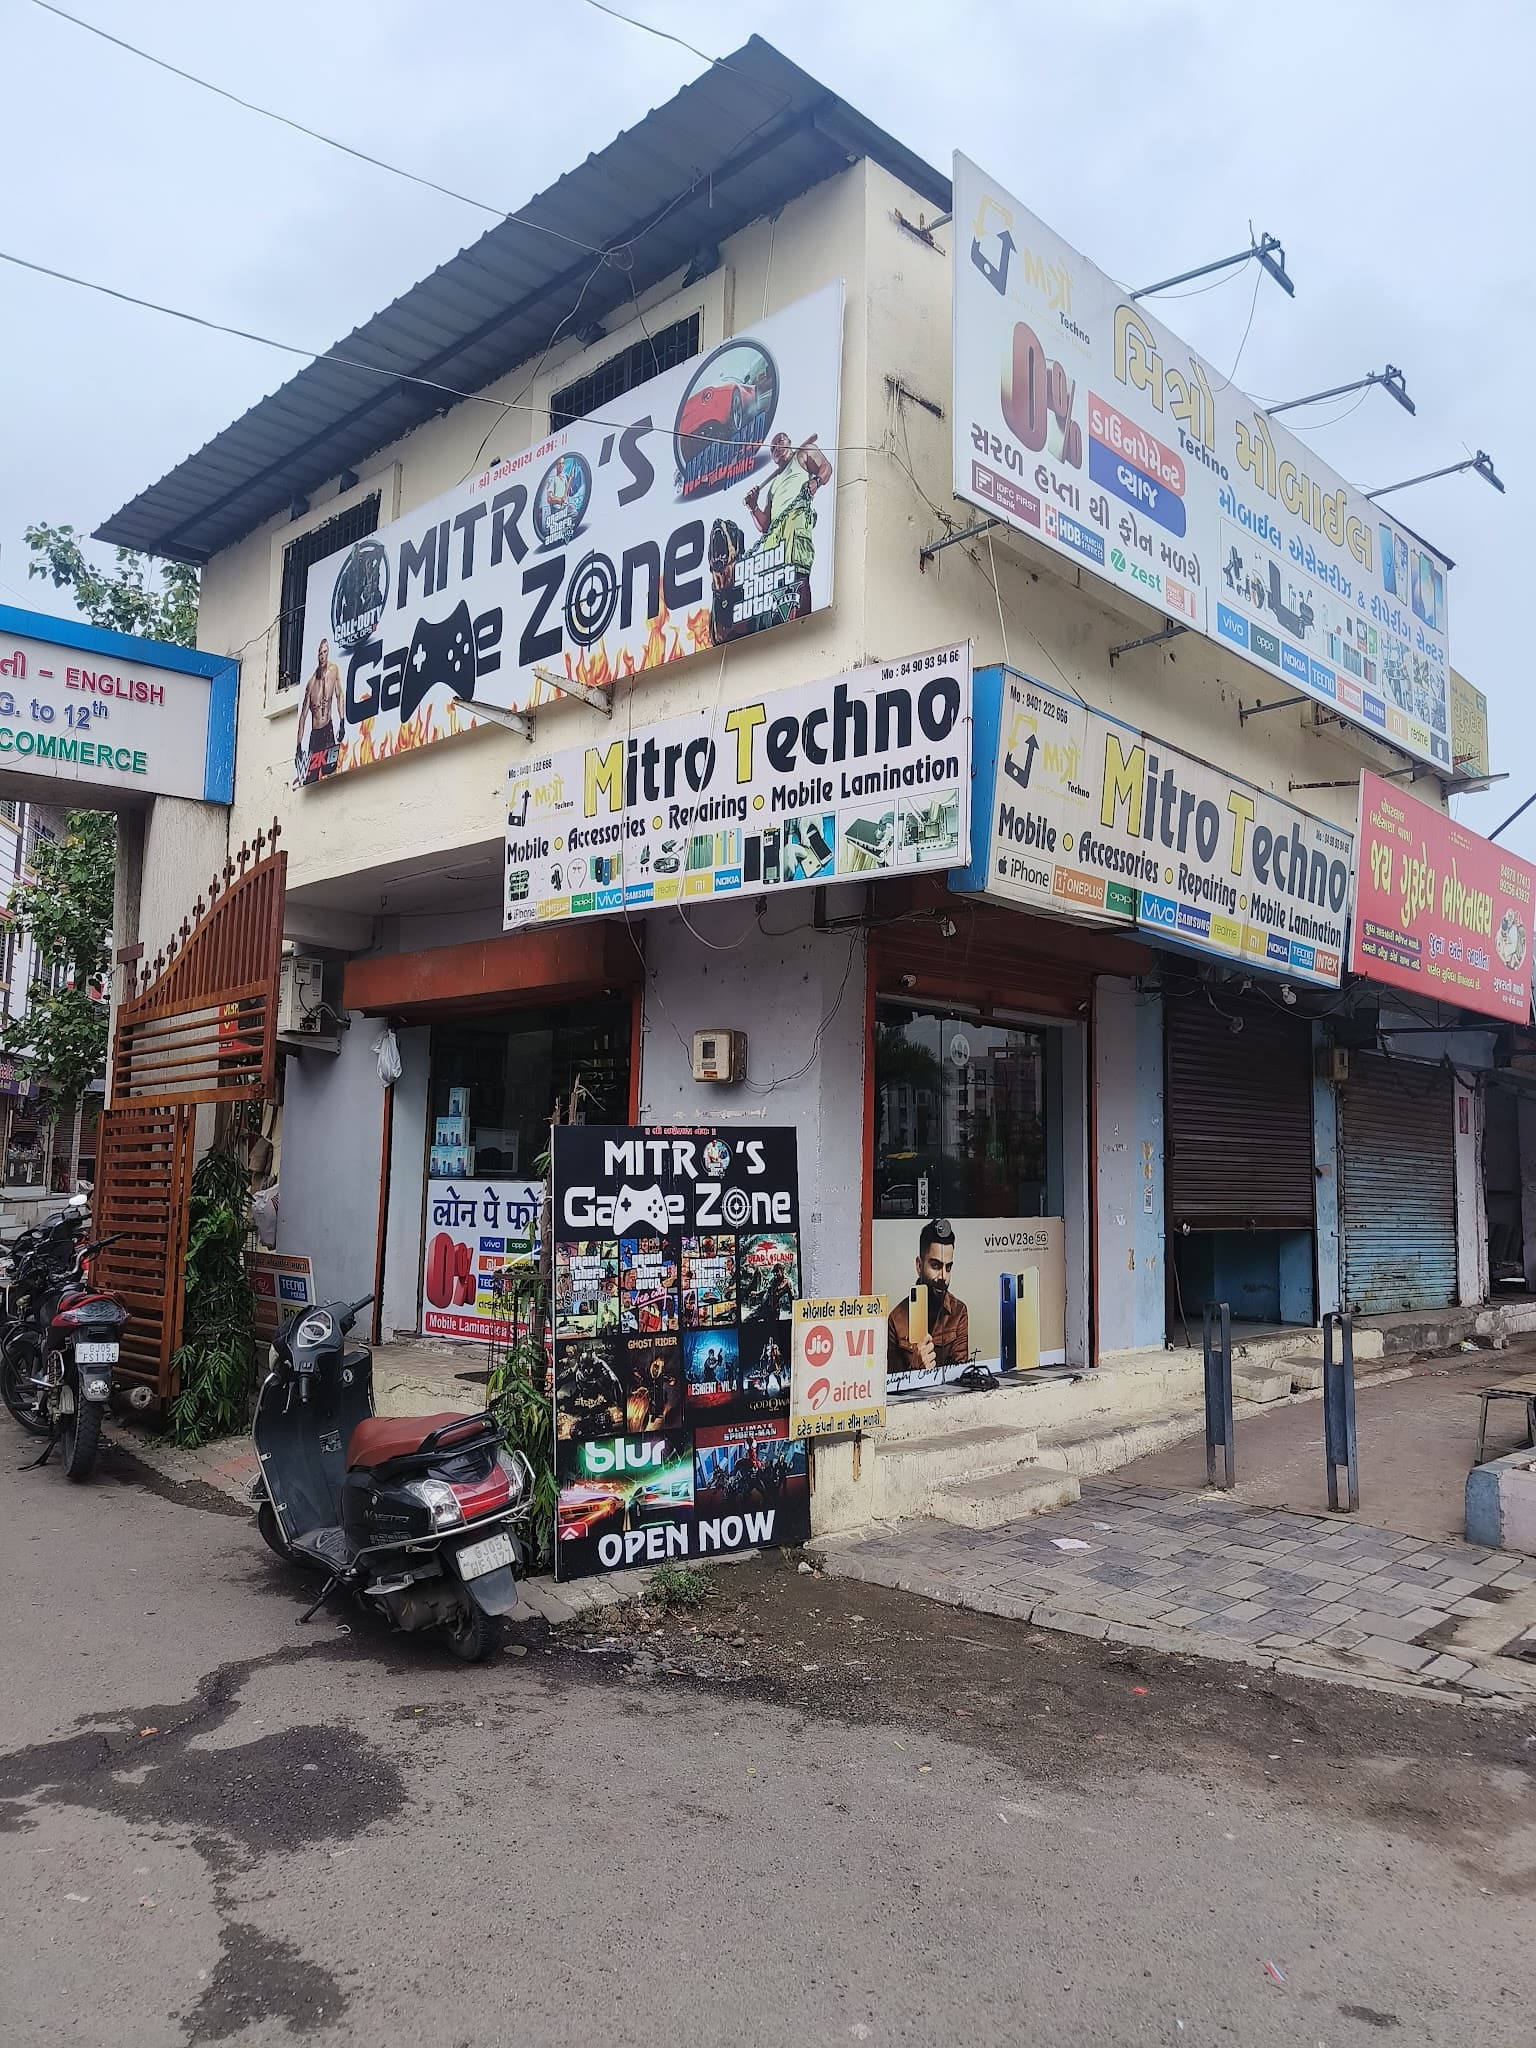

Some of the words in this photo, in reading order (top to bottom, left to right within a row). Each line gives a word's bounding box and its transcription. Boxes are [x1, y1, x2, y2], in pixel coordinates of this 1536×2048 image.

[1114, 304, 1215, 452] મિત્રો
[1000, 321, 1083, 470] 0%
[1178, 427, 1229, 481] Techno
[478, 471, 490, 489] શ્રી
[493, 452, 533, 481] ગણેશાય
[1116, 464, 1159, 509] વ્યાજ
[970, 423, 1023, 477] સરળ
[1034, 464, 1080, 512] હપ્તા
[1089, 496, 1110, 530] થી
[1119, 512, 1153, 557] ફોન
[1161, 542, 1201, 586] મળશે
[996, 482, 1015, 501] IDFC
[1015, 493, 1038, 513] FIRST
[996, 493, 1016, 511] Bank
[1235, 412, 1373, 573] મોબાઈલ
[1059, 516, 1081, 546] HDB
[1219, 485, 1282, 551] મોબાઈલ
[1358, 590, 1366, 609] &
[1130, 563, 1162, 593] zest
[335, 617, 355, 641] CALL
[357, 604, 382, 631] DUTY
[901, 663, 910, 676] 84
[912, 659, 923, 672] 90
[924, 656, 935, 669] 93
[937, 653, 947, 666] 94
[949, 649, 960, 662] 66
[1222, 615, 1245, 637] vivo
[1256, 635, 1275, 652] oppo
[1283, 651, 1307, 675] NOKIA
[1312, 668, 1335, 692] TECNO
[65, 667, 165, 705] ENGLISH
[31, 698, 55, 723] to
[64, 700, 109, 730] 12th
[1026, 693, 1042, 712] 8401
[1043, 701, 1056, 719] 222
[1056, 707, 1068, 724] 666
[0, 727, 148, 774] COMMERCE
[583, 736, 716, 819] Mitro
[724, 676, 961, 786] Techno
[554, 801, 574, 810] Techno
[1067, 781, 1090, 799] Techno
[507, 836, 549, 865] Mobile
[568, 816, 646, 853] Accessories
[669, 793, 747, 830] Repairing
[771, 776, 833, 813] Mobile
[840, 754, 958, 799] Lamination
[1100, 732, 1220, 864] Mitro
[1226, 790, 1348, 914] Techno
[998, 803, 1057, 853] Mobile
[1078, 831, 1160, 884] Accessories
[1177, 862, 1237, 916] Repairing
[1250, 893, 1286, 929] Mobile
[1288, 907, 1342, 949] Lamination
[1371, 839, 1393, 896] જય
[1441, 857, 1493, 938] ભોજનાલય
[513, 904, 536, 920] iPhone
[574, 898, 593, 907] oppo
[597, 891, 623, 907] vivo
[625, 887, 653, 901] SAMSUNG
[715, 875, 739, 887] NOKIA
[1010, 858, 1049, 888] iPhone
[1067, 880, 1105, 901] ONEPLUS
[1144, 897, 1177, 924] vivo
[1178, 912, 1211, 932] SAMSUNG
[1214, 924, 1237, 940] realme
[1268, 943, 1288, 957] NOKIA
[1293, 946, 1314, 960] TECNO
[433, 1186, 477, 1228] लोन
[484, 1241, 501, 1249] vivo
[984, 1233, 1009, 1247] vivo
[1009, 1232, 1034, 1246] V23e
[1036, 1233, 1047, 1243] 5G
[427, 1232, 476, 1309] 0%
[747, 1254, 765, 1264] DEAD
[281, 1279, 304, 1292] TECNO
[429, 1315, 456, 1330] Mobile
[459, 1318, 507, 1337] Lamination
[802, 1301, 836, 1319] મોબાઈલ
[83, 1353, 116, 1361] FS1125
[628, 1338, 652, 1350] GHOST
[655, 1336, 677, 1347] RIDER
[807, 1334, 832, 1355] Jio
[688, 1381, 717, 1397] RESIDENT
[717, 1380, 731, 1392] EVIL
[732, 1380, 737, 1392] 4
[833, 1380, 872, 1402] airtel
[749, 1400, 768, 1410] GOD
[723, 1428, 777, 1441] SPIDER-MAN
[728, 1423, 773, 1433] ULTIMATE
[797, 1419, 813, 1436] દરેક
[815, 1415, 835, 1433] કંપની
[847, 1414, 861, 1429] સીમ
[585, 1438, 666, 1473] blur
[598, 1523, 689, 1568] OPEN
[700, 1509, 776, 1553] NOW
